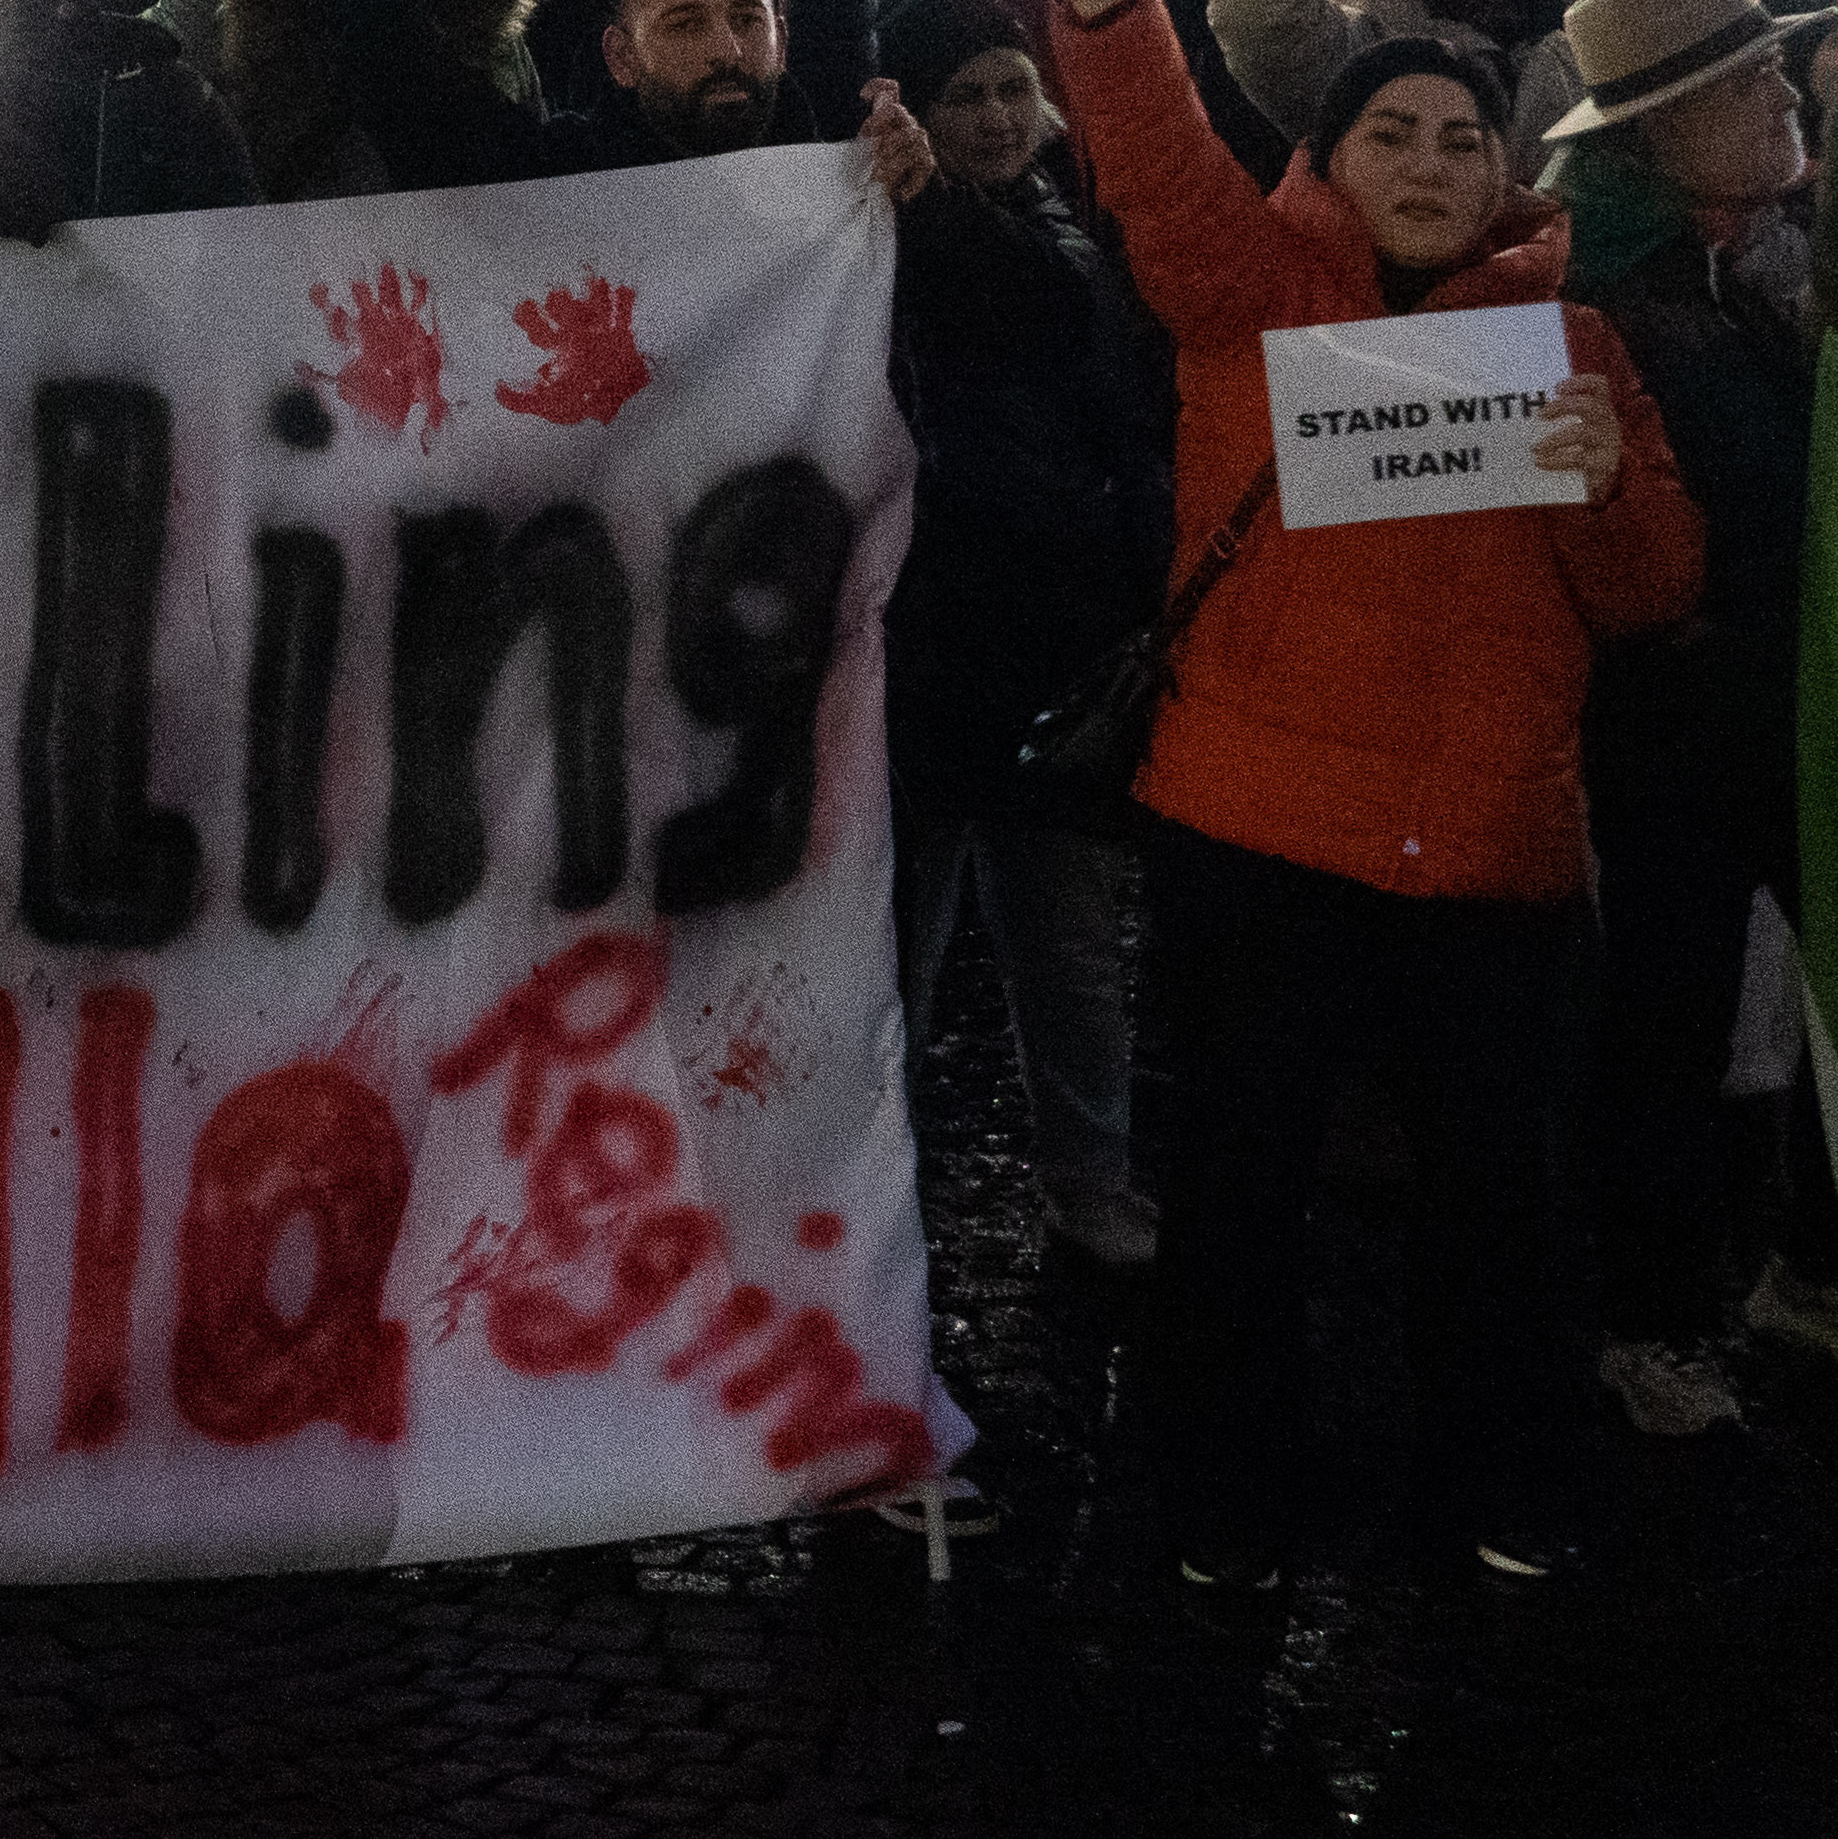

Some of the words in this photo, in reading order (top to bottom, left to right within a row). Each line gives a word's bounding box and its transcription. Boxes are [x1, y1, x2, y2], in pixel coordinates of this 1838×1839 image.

[1295, 402, 1431, 439] STAND
[1439, 389, 1547, 425] WITH
[1373, 446, 1483, 482] IRAN!
